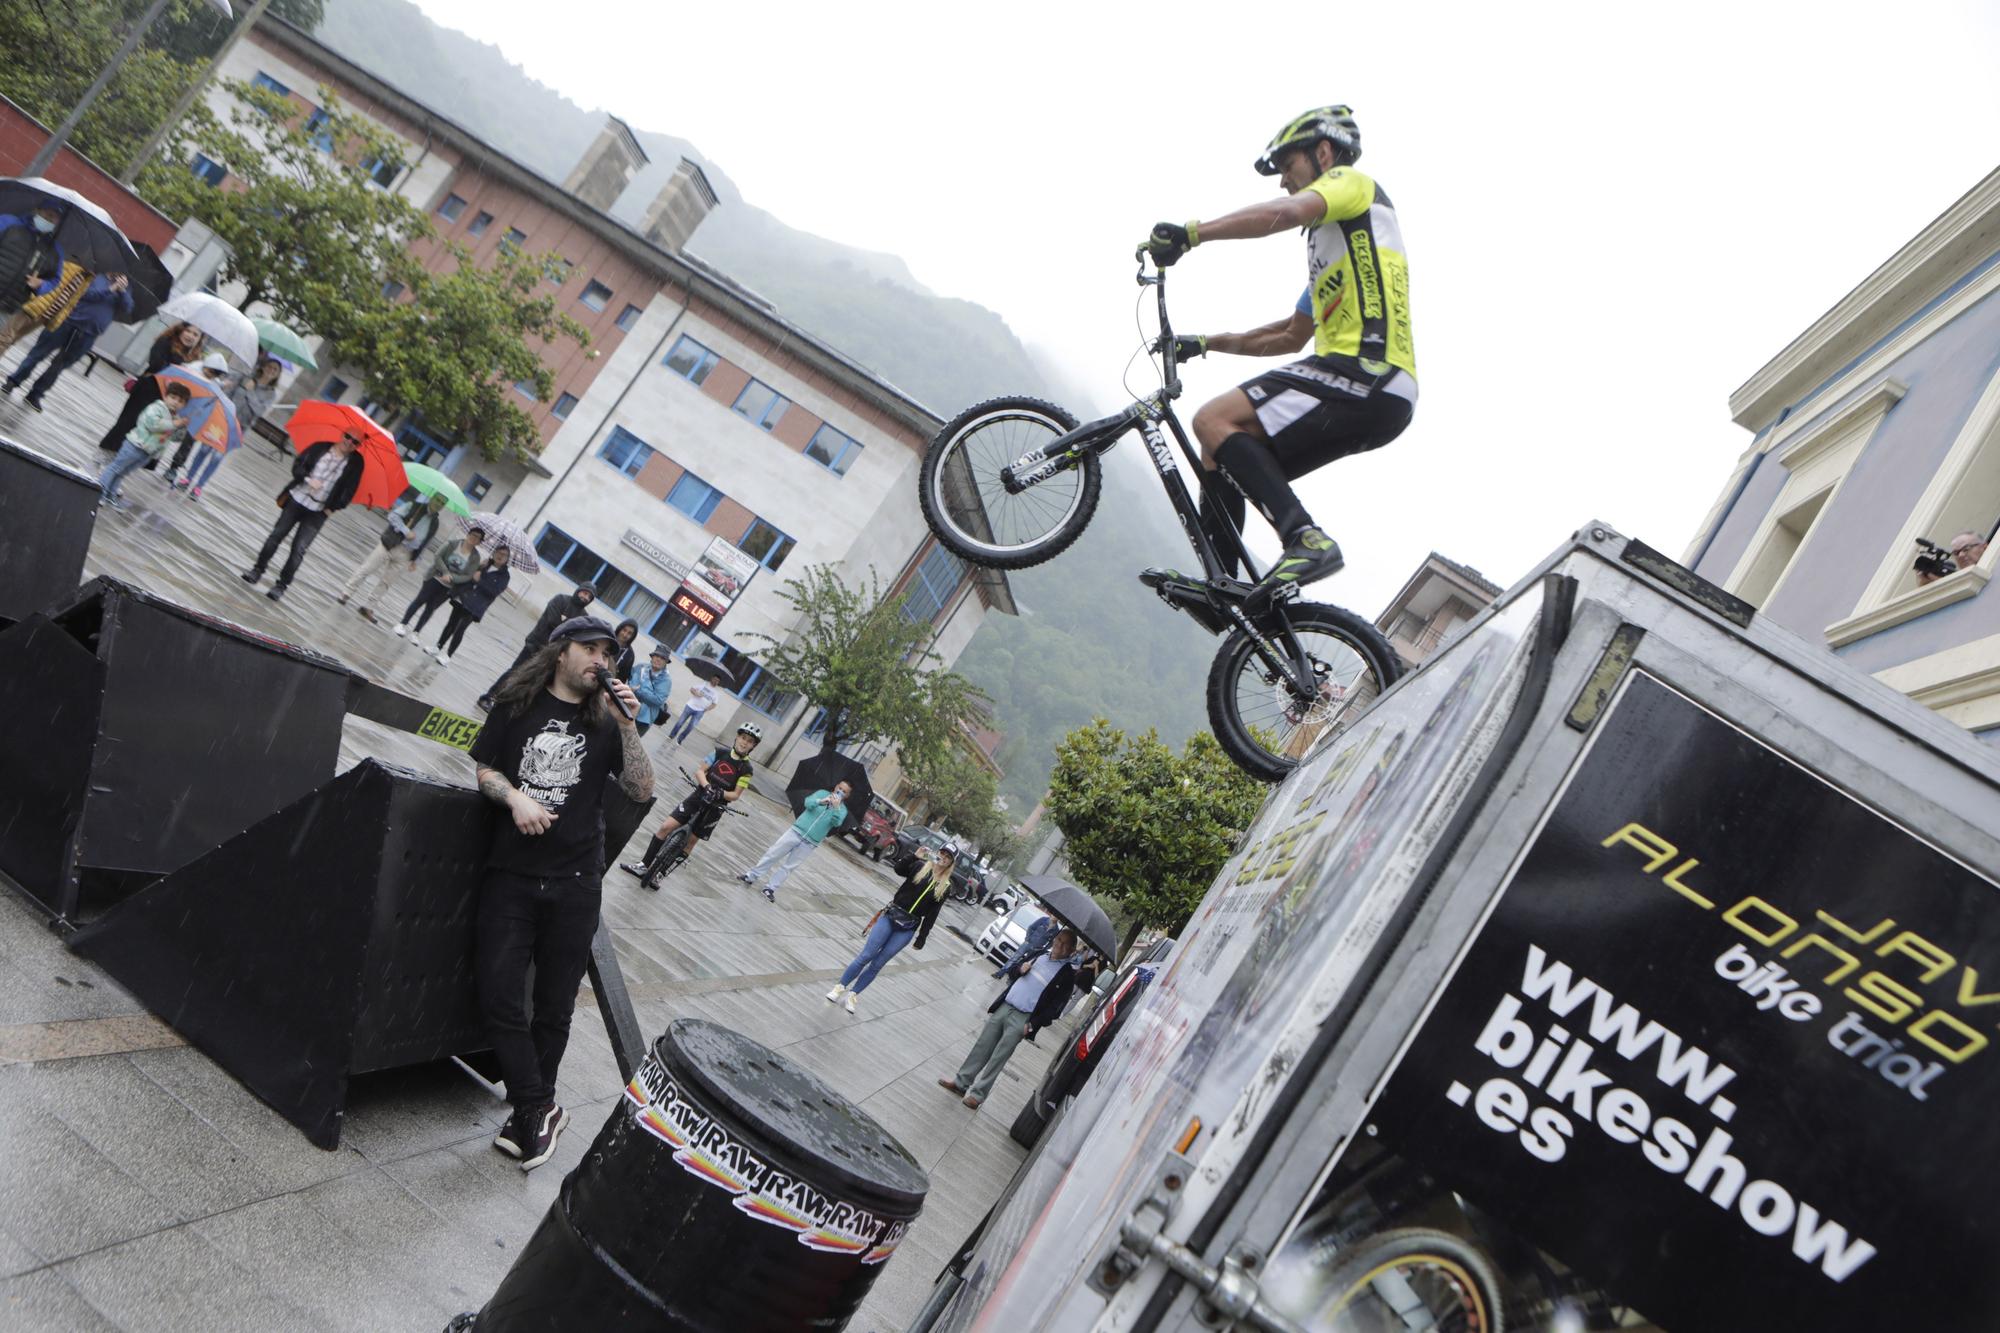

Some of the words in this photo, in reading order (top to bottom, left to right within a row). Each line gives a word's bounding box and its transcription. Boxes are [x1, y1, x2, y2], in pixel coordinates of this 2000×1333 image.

[631, 535, 661, 557] CENTRO
[660, 553, 671, 565] DE
[668, 560, 689, 577] SALU
[677, 595, 692, 611] DE
[421, 712, 480, 747] BIKES
[1601, 822, 1989, 1063] ALONSO
[1816, 909, 2000, 1010] JAV
[1522, 943, 1737, 1123] www.
[1714, 943, 1822, 1022] bike
[1826, 1011, 1947, 1101] trial
[659, 1084, 701, 1137] RAW
[1446, 1078, 1574, 1163] .es
[1474, 993, 1878, 1284] bikeshow
[701, 1126, 762, 1182] RAW
[765, 1175, 829, 1219] RAW
[828, 1205, 880, 1239] RAW
